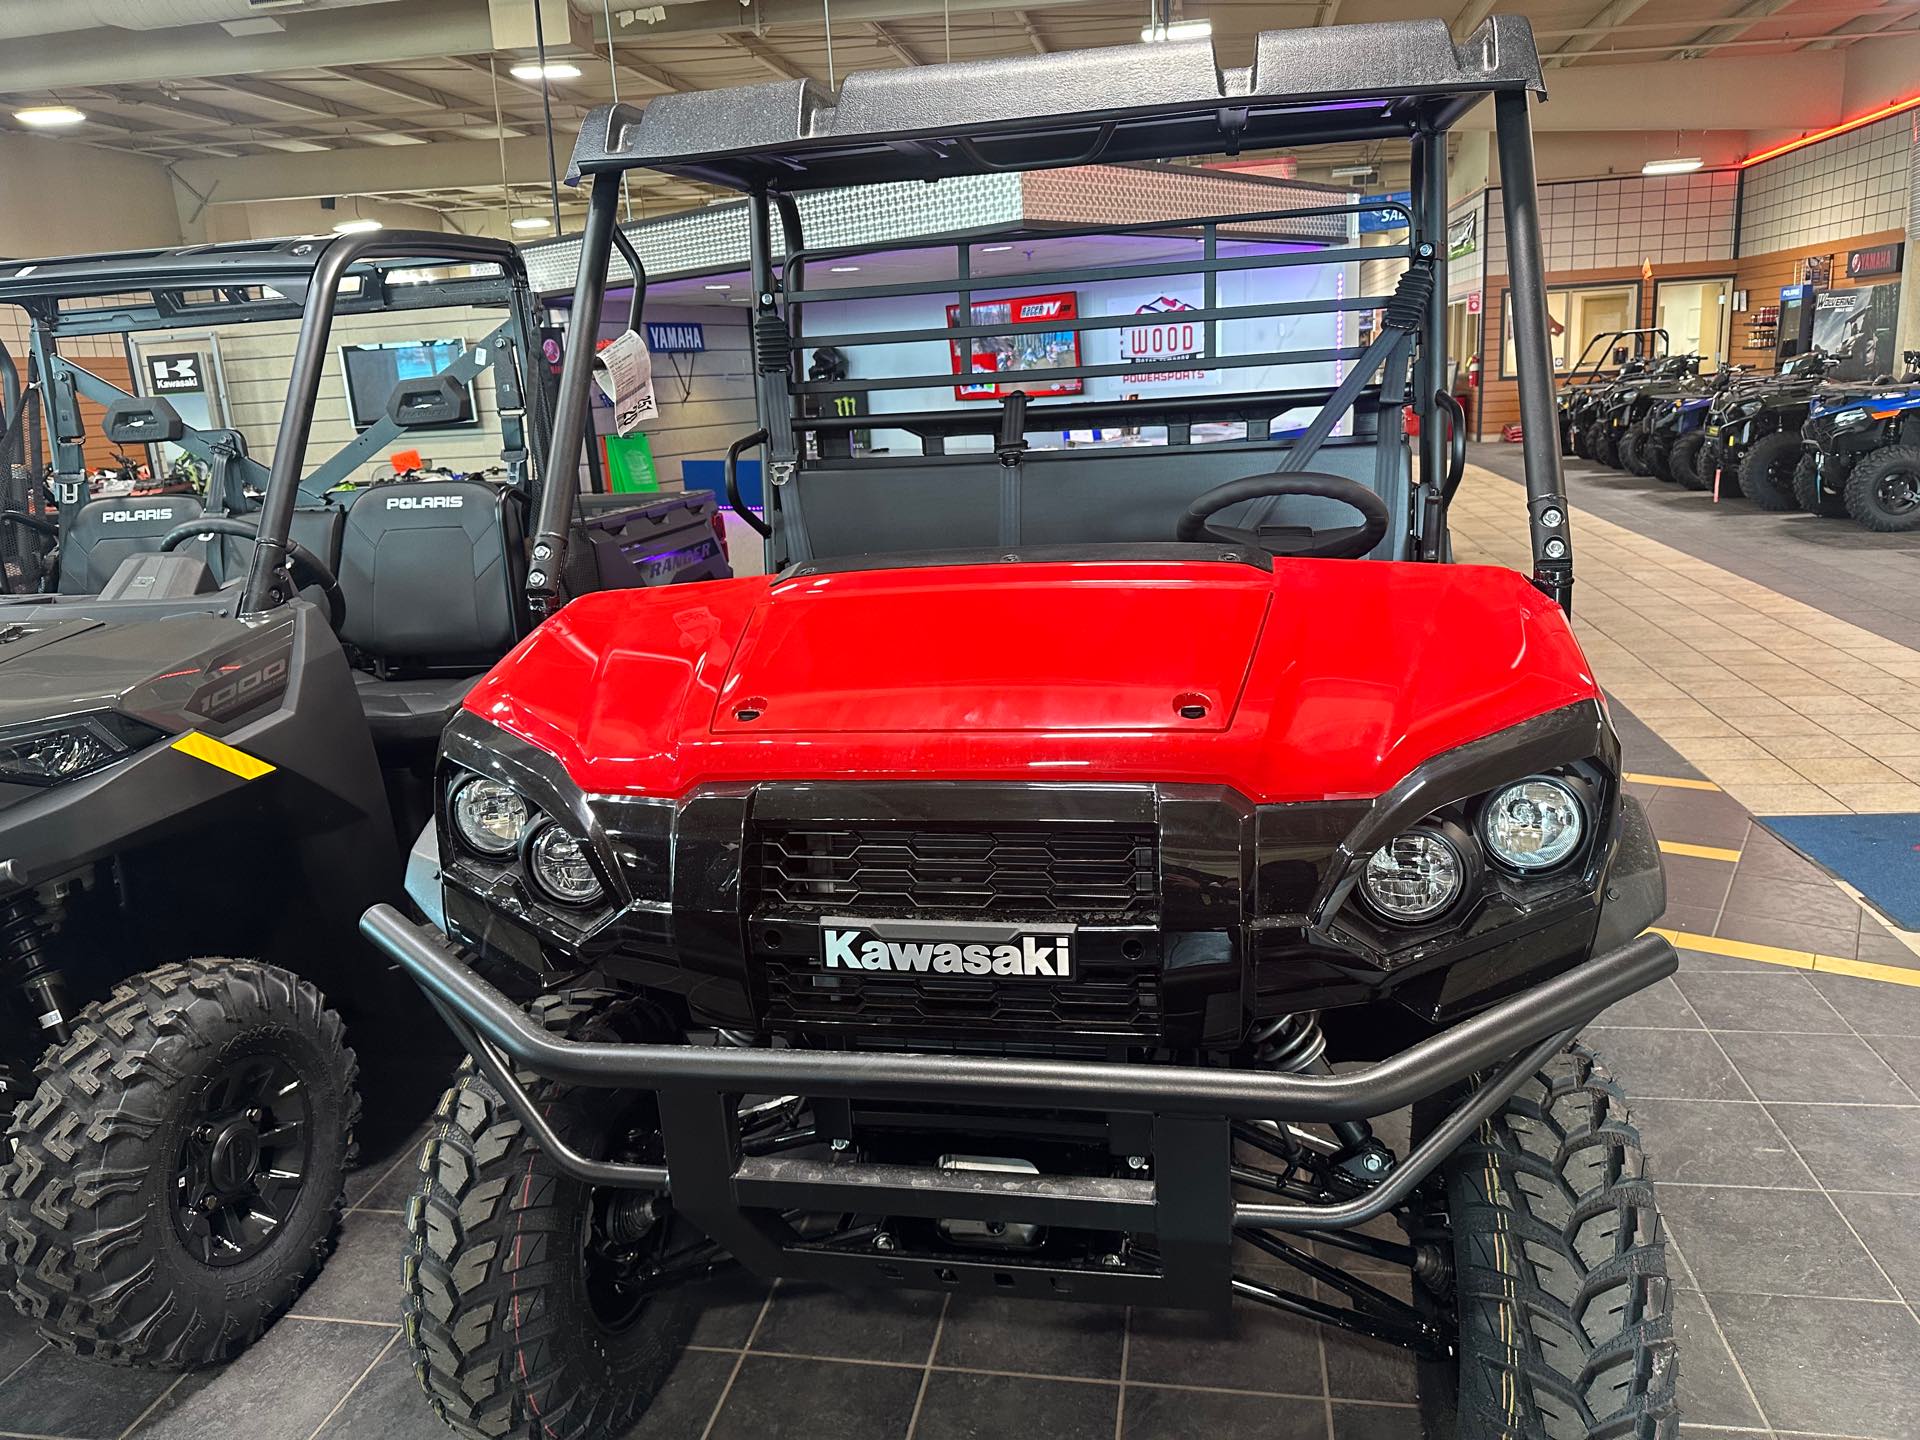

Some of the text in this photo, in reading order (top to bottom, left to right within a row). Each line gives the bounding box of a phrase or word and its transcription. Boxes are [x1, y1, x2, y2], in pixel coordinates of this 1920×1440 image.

[1860, 250, 1891, 271] YAMAHA
[650, 327, 702, 349] YAMAHA
[1131, 325, 1194, 354] WOOD
[156, 377, 198, 389] Kawasaki
[1122, 370, 1205, 384] POWERSPORTS
[386, 496, 463, 510] POLARIS
[102, 508, 173, 523] POLARIS
[650, 542, 711, 579] RANGER
[200, 658, 286, 713] 1000
[824, 930, 1071, 977] Kawasaki
